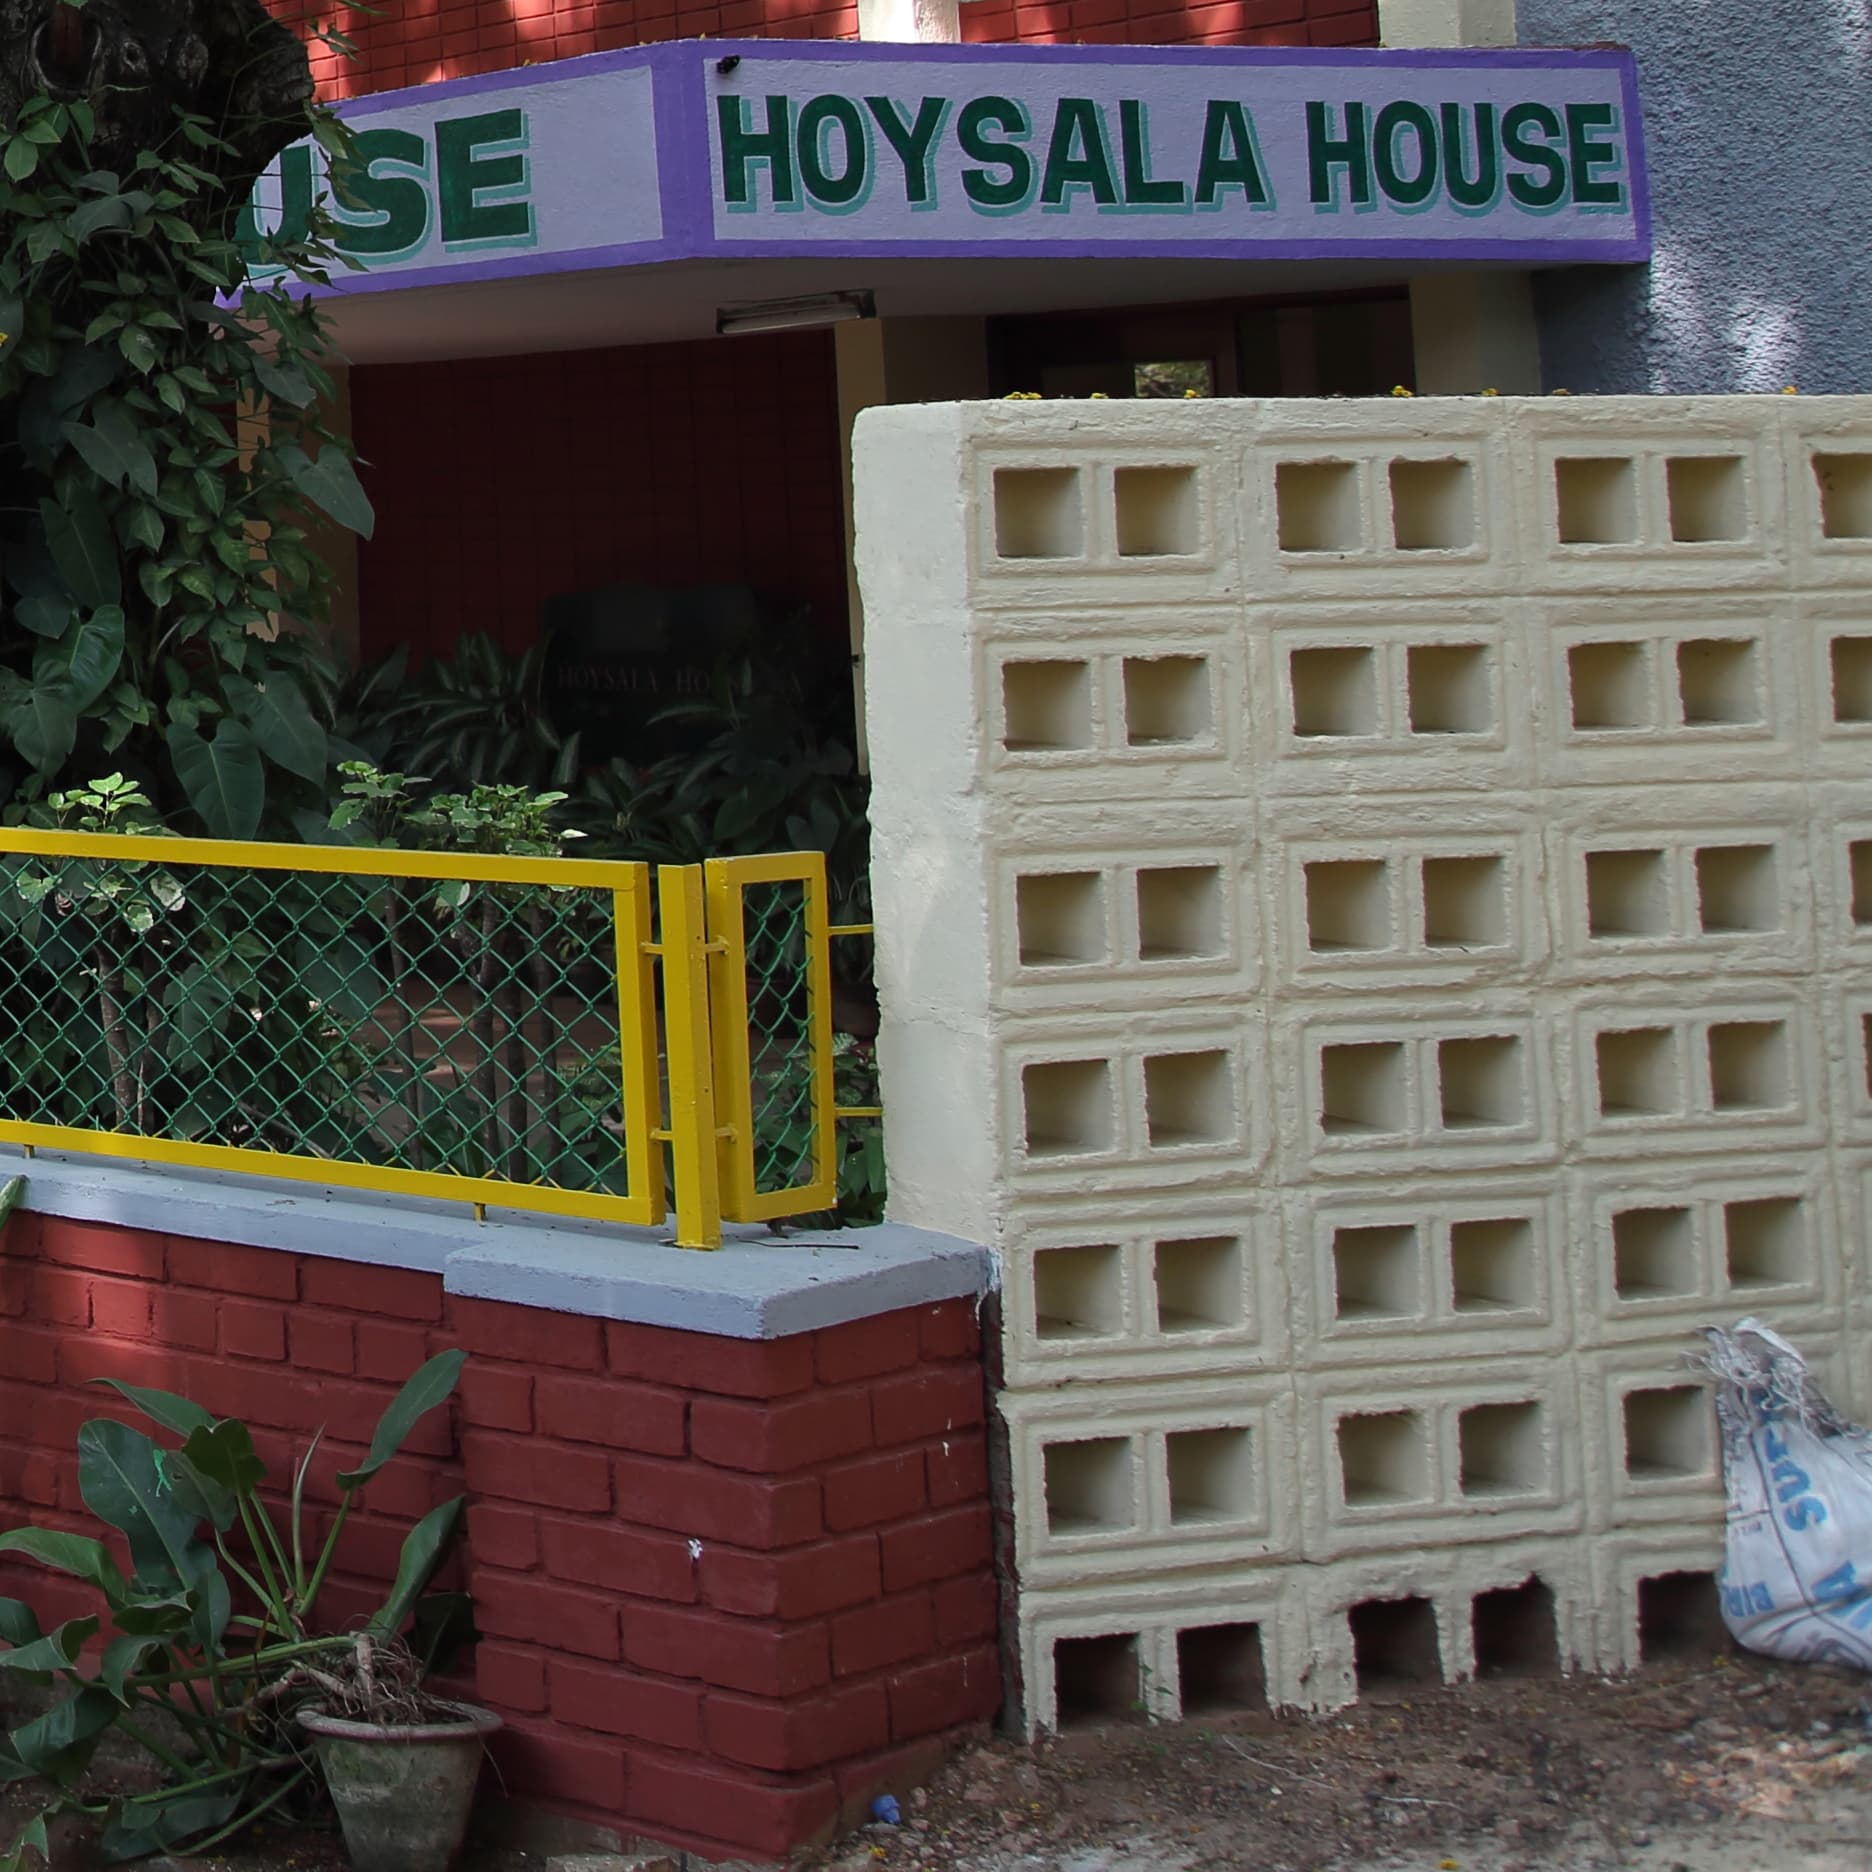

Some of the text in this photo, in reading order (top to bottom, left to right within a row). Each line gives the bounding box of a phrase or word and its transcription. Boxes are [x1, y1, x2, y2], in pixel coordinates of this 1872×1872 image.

[230, 107, 538, 273] USE
[716, 93, 1630, 217] HOYSALA HOUSE
